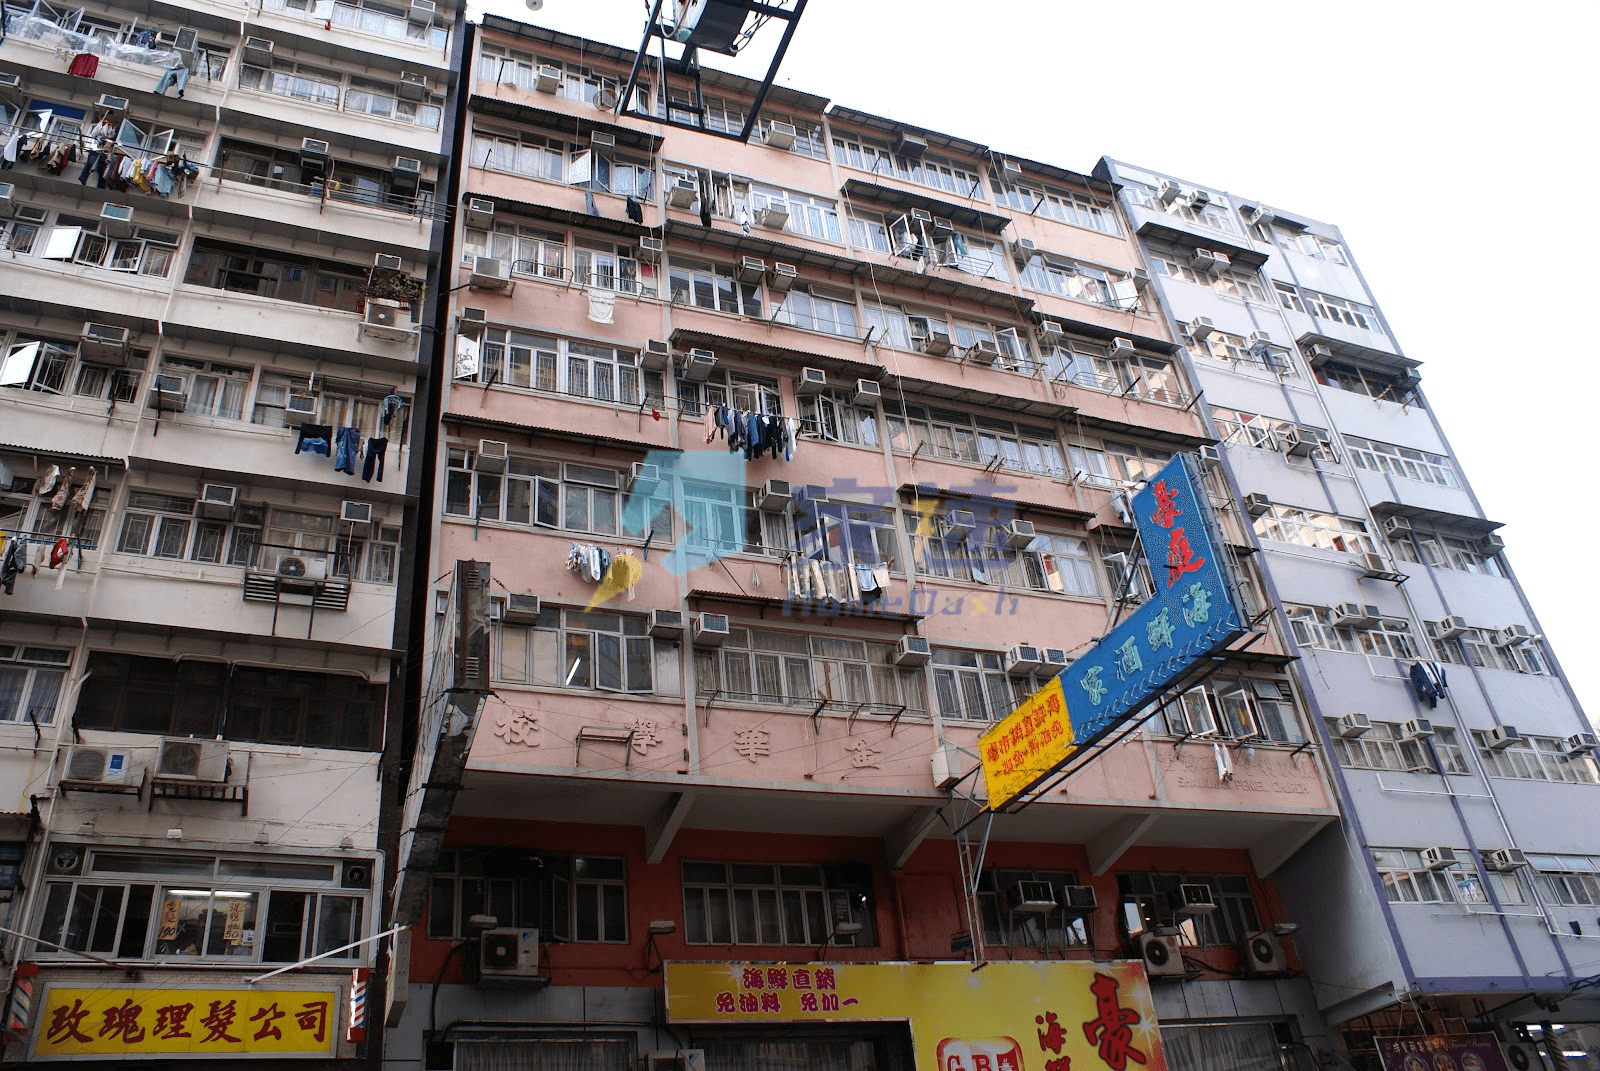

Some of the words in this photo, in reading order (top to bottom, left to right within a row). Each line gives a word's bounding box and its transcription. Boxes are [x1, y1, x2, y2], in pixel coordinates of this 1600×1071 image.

[742, 966, 836, 991] 海鮮直銷
[715, 992, 781, 1014] 免油料
[800, 992, 859, 1013] 免加一
[46, 998, 327, 1045] 玫瑰理髮公司
